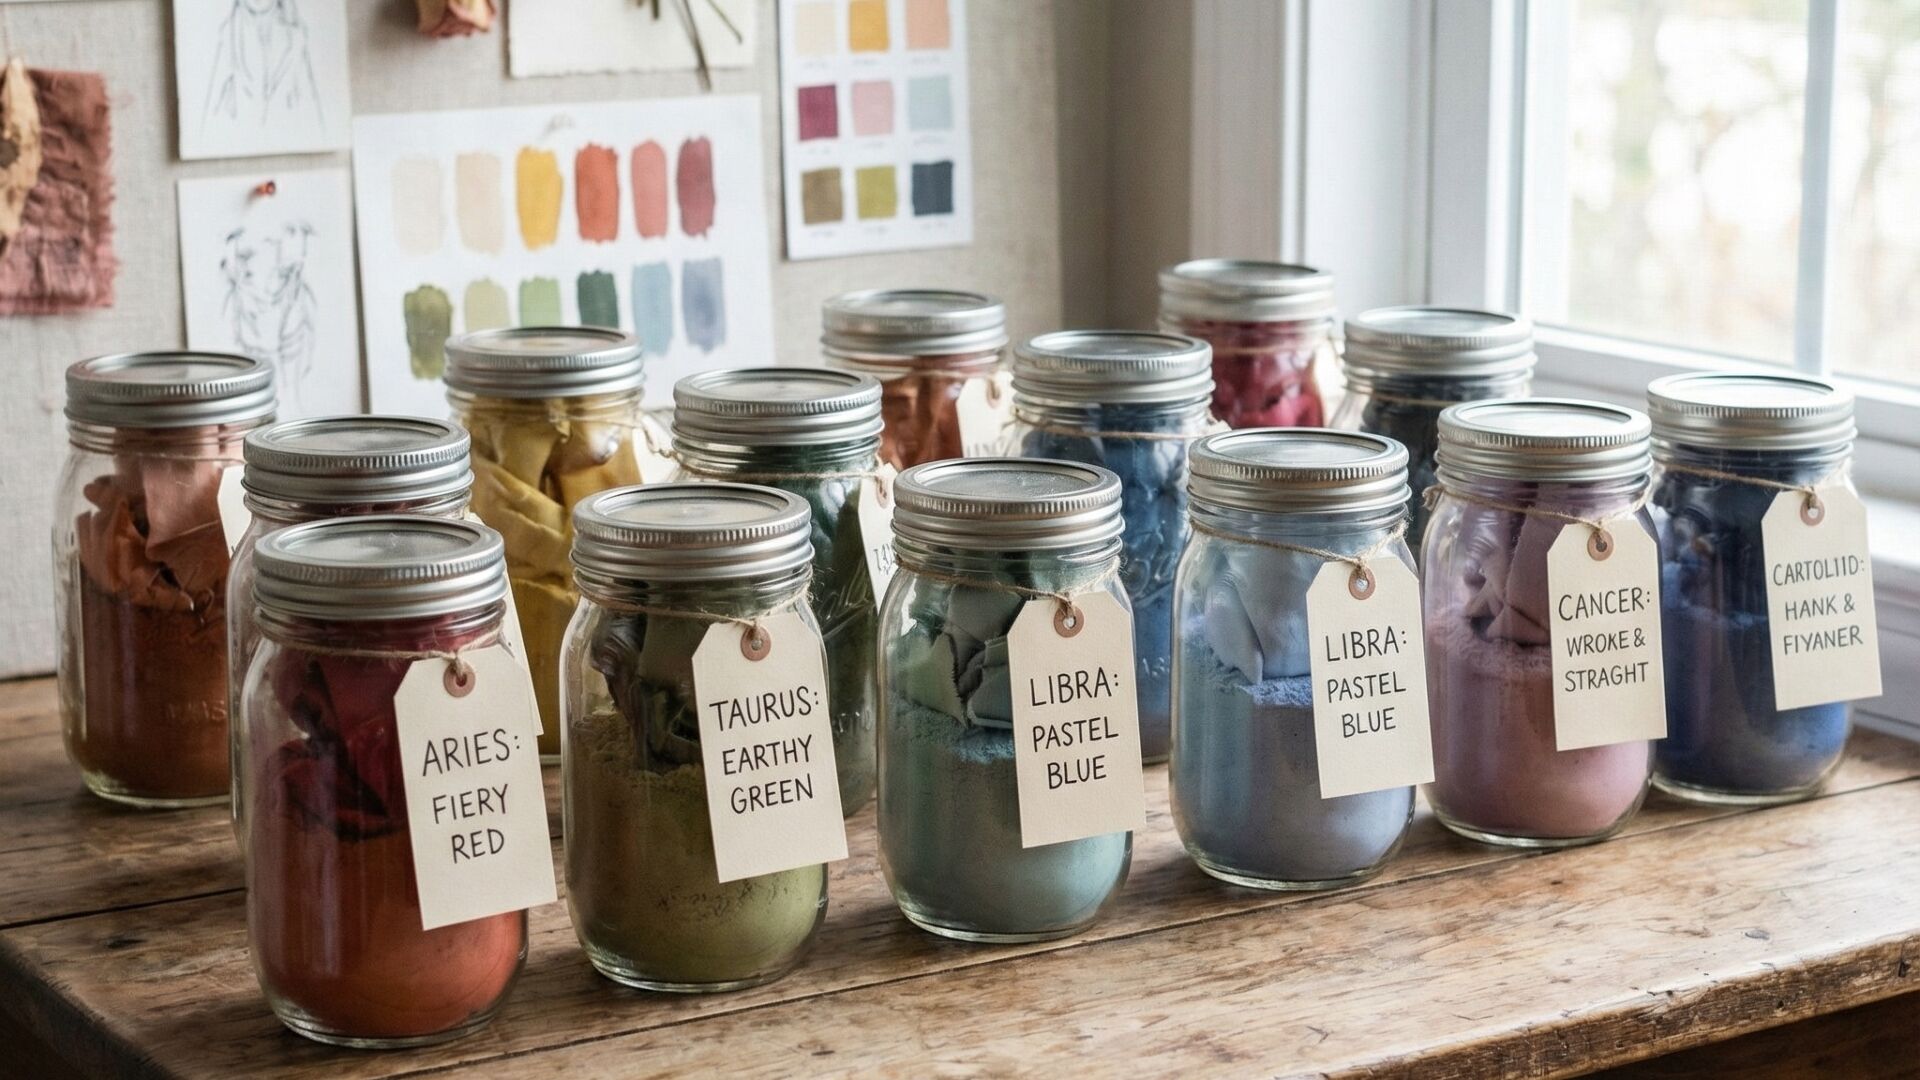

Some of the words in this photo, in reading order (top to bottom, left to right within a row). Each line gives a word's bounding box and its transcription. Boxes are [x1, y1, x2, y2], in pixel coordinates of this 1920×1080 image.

[1558, 587, 1650, 621] CANCER:
[1785, 595, 1838, 621] HANK
[1843, 593, 1855, 613] &
[1325, 626, 1407, 662] LIBRA:
[1566, 631, 1629, 657] WROKE
[1633, 627, 1646, 648] &
[1783, 625, 1863, 655] FIYANER
[1030, 666, 1119, 706] LIBRA:
[1327, 671, 1406, 704] PASTEL
[1565, 661, 1649, 692] STRAGHT
[709, 685, 819, 732] TAURUS:
[1342, 707, 1396, 738] BLUE
[422, 728, 520, 776] ARIES:
[1032, 716, 1119, 753] PASTEL
[722, 734, 812, 775] EARTHY
[1047, 755, 1107, 790] BLUE
[432, 783, 508, 824] FIERY
[731, 773, 813, 814] GREEN
[451, 828, 505, 864] RED
